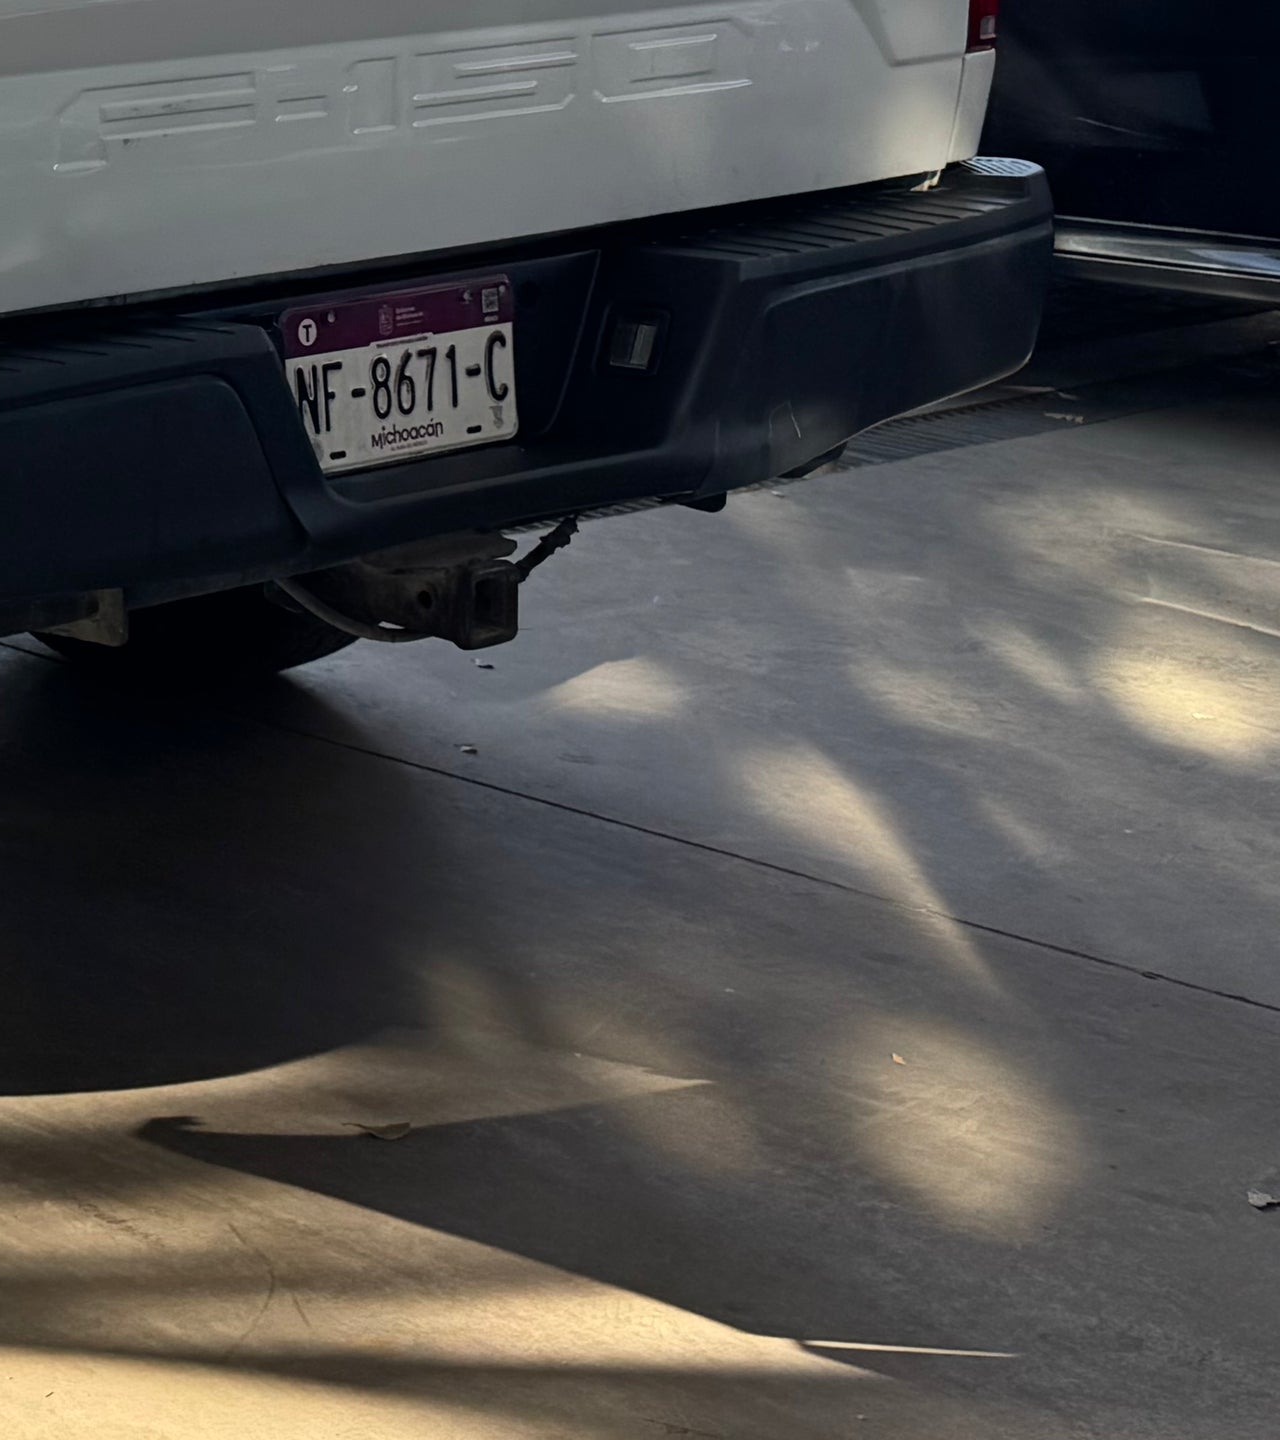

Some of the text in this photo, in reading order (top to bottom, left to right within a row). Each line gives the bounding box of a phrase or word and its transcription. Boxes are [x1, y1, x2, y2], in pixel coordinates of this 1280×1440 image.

[301, 324, 313, 343] T
[296, 330, 509, 435] NF-8671-C
[371, 418, 444, 449] Michoacán
